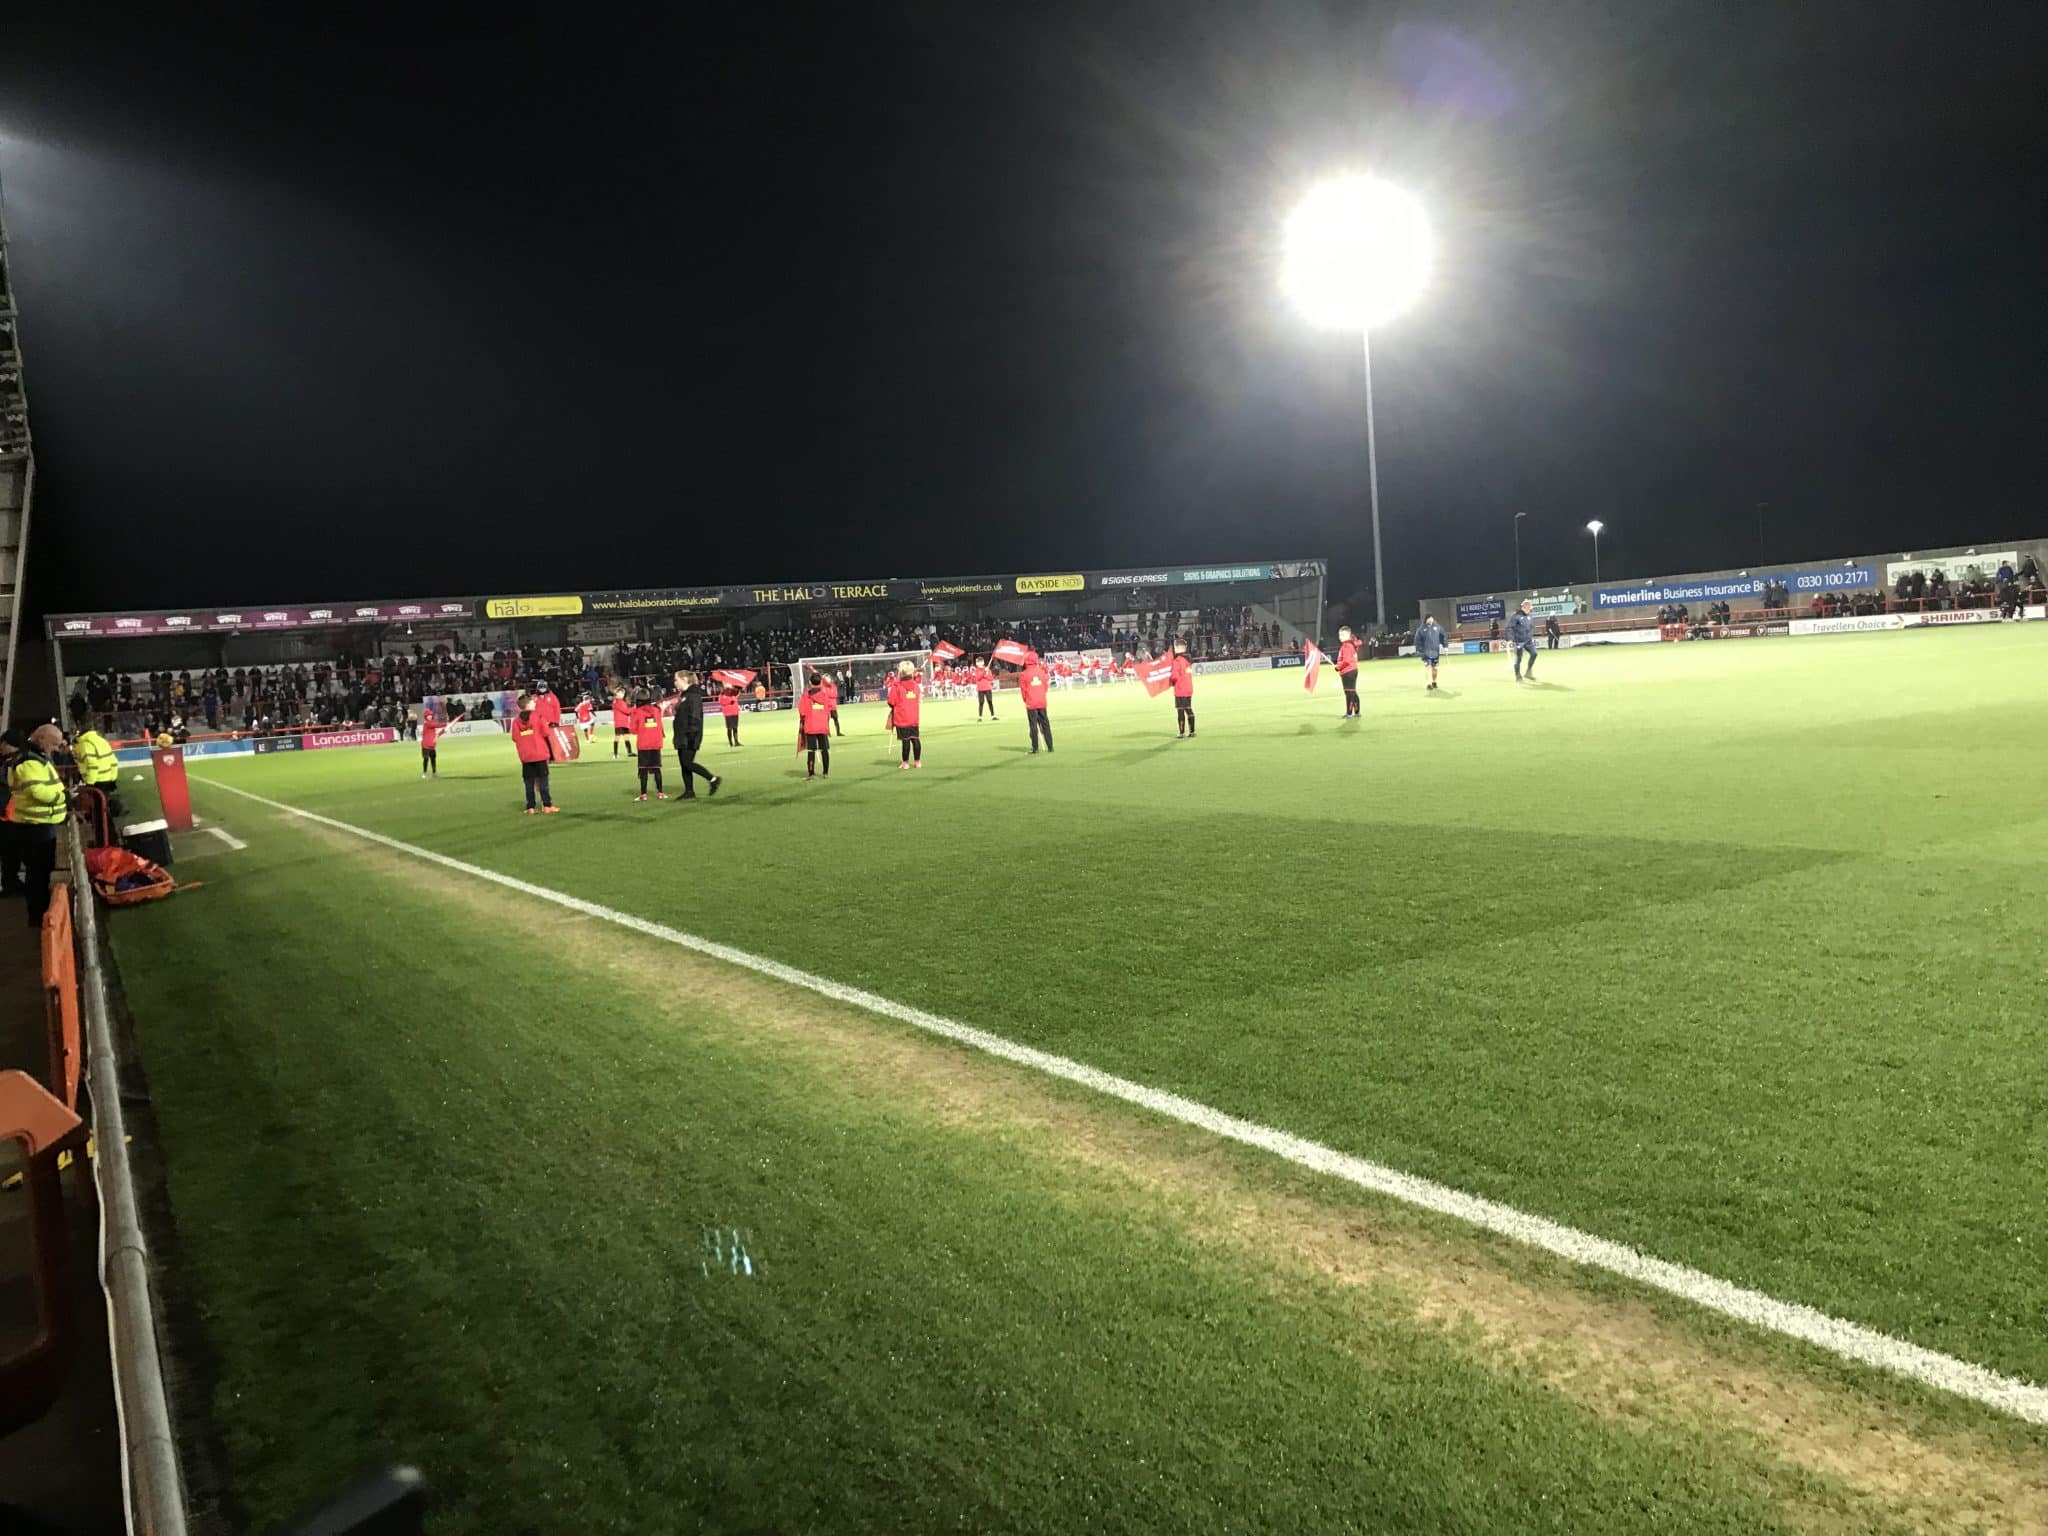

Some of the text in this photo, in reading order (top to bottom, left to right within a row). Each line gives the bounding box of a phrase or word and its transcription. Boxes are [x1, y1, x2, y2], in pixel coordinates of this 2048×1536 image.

[1020, 580, 1059, 591] BAYSIDE
[1107, 573, 1168, 585] SIGNS EXPRESS
[753, 584, 889, 603] THE HALO TERRACE
[921, 583, 1003, 596] www.baysidendt.co.uk
[1600, 590, 1662, 605] Premierline
[1663, 586, 1703, 600] Business
[1704, 582, 1751, 597] Insurance
[1797, 575, 1822, 588] 0330
[1825, 573, 1844, 586] 100
[1845, 570, 1868, 584] 2171
[494, 599, 531, 617] halo
[592, 596, 720, 610] www.halolaboratoriesuk.com
[1812, 620, 1887, 633] Travellers Choice
[863, 692, 879, 702] bet
[560, 718, 577, 726] Lord
[450, 724, 471, 734] Lord
[312, 731, 385, 747] Lancastrian
